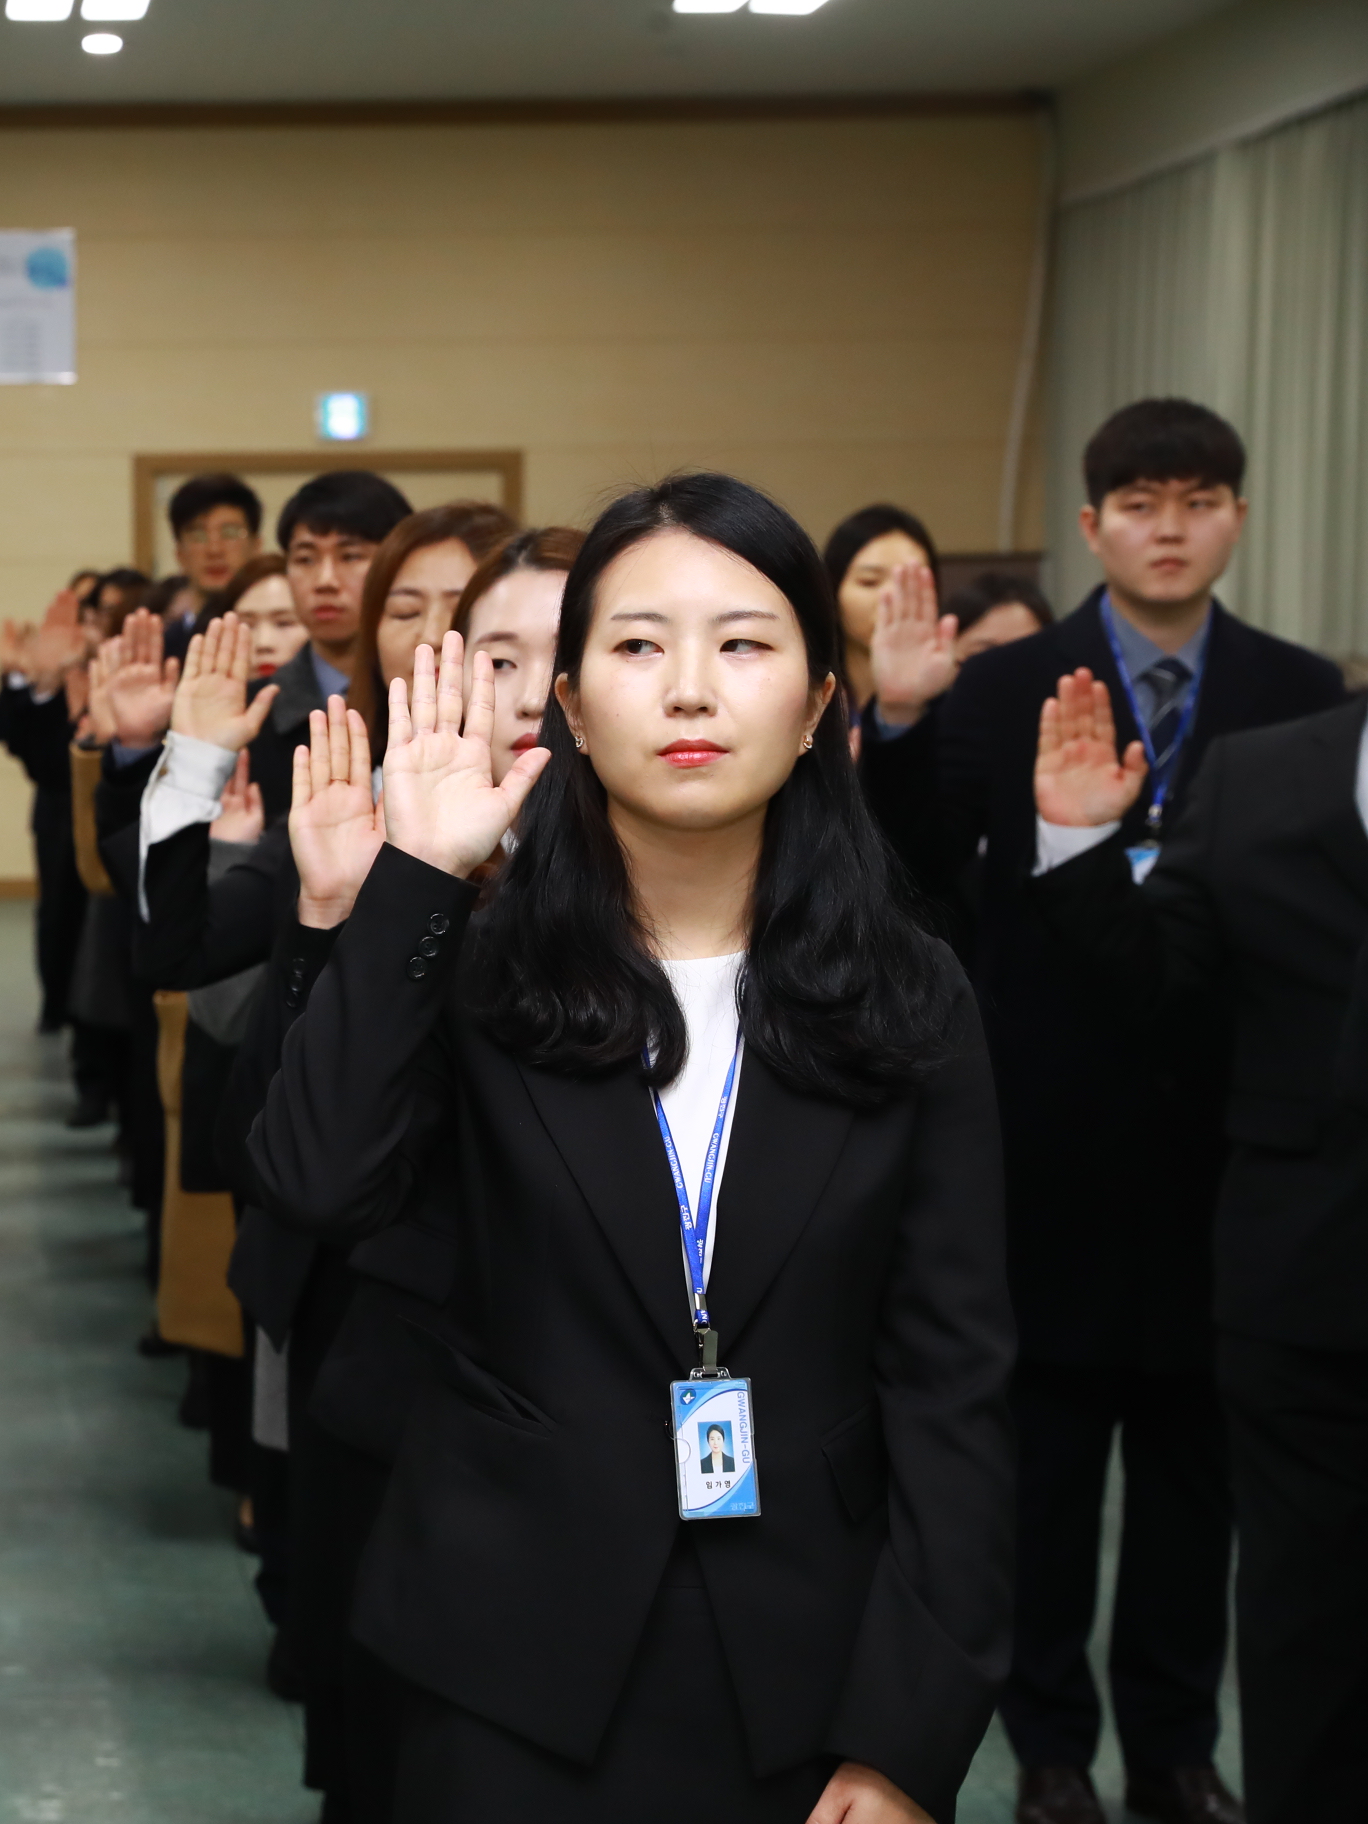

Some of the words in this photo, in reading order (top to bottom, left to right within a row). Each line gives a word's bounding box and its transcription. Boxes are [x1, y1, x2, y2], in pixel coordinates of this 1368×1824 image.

[663, 1136, 684, 1189] GWANGJIN-GU
[703, 1132, 720, 1183] GWANGJIN-GU
[680, 1204, 693, 1231] 광진구
[737, 1391, 751, 1464] GWANGJIN-GU
